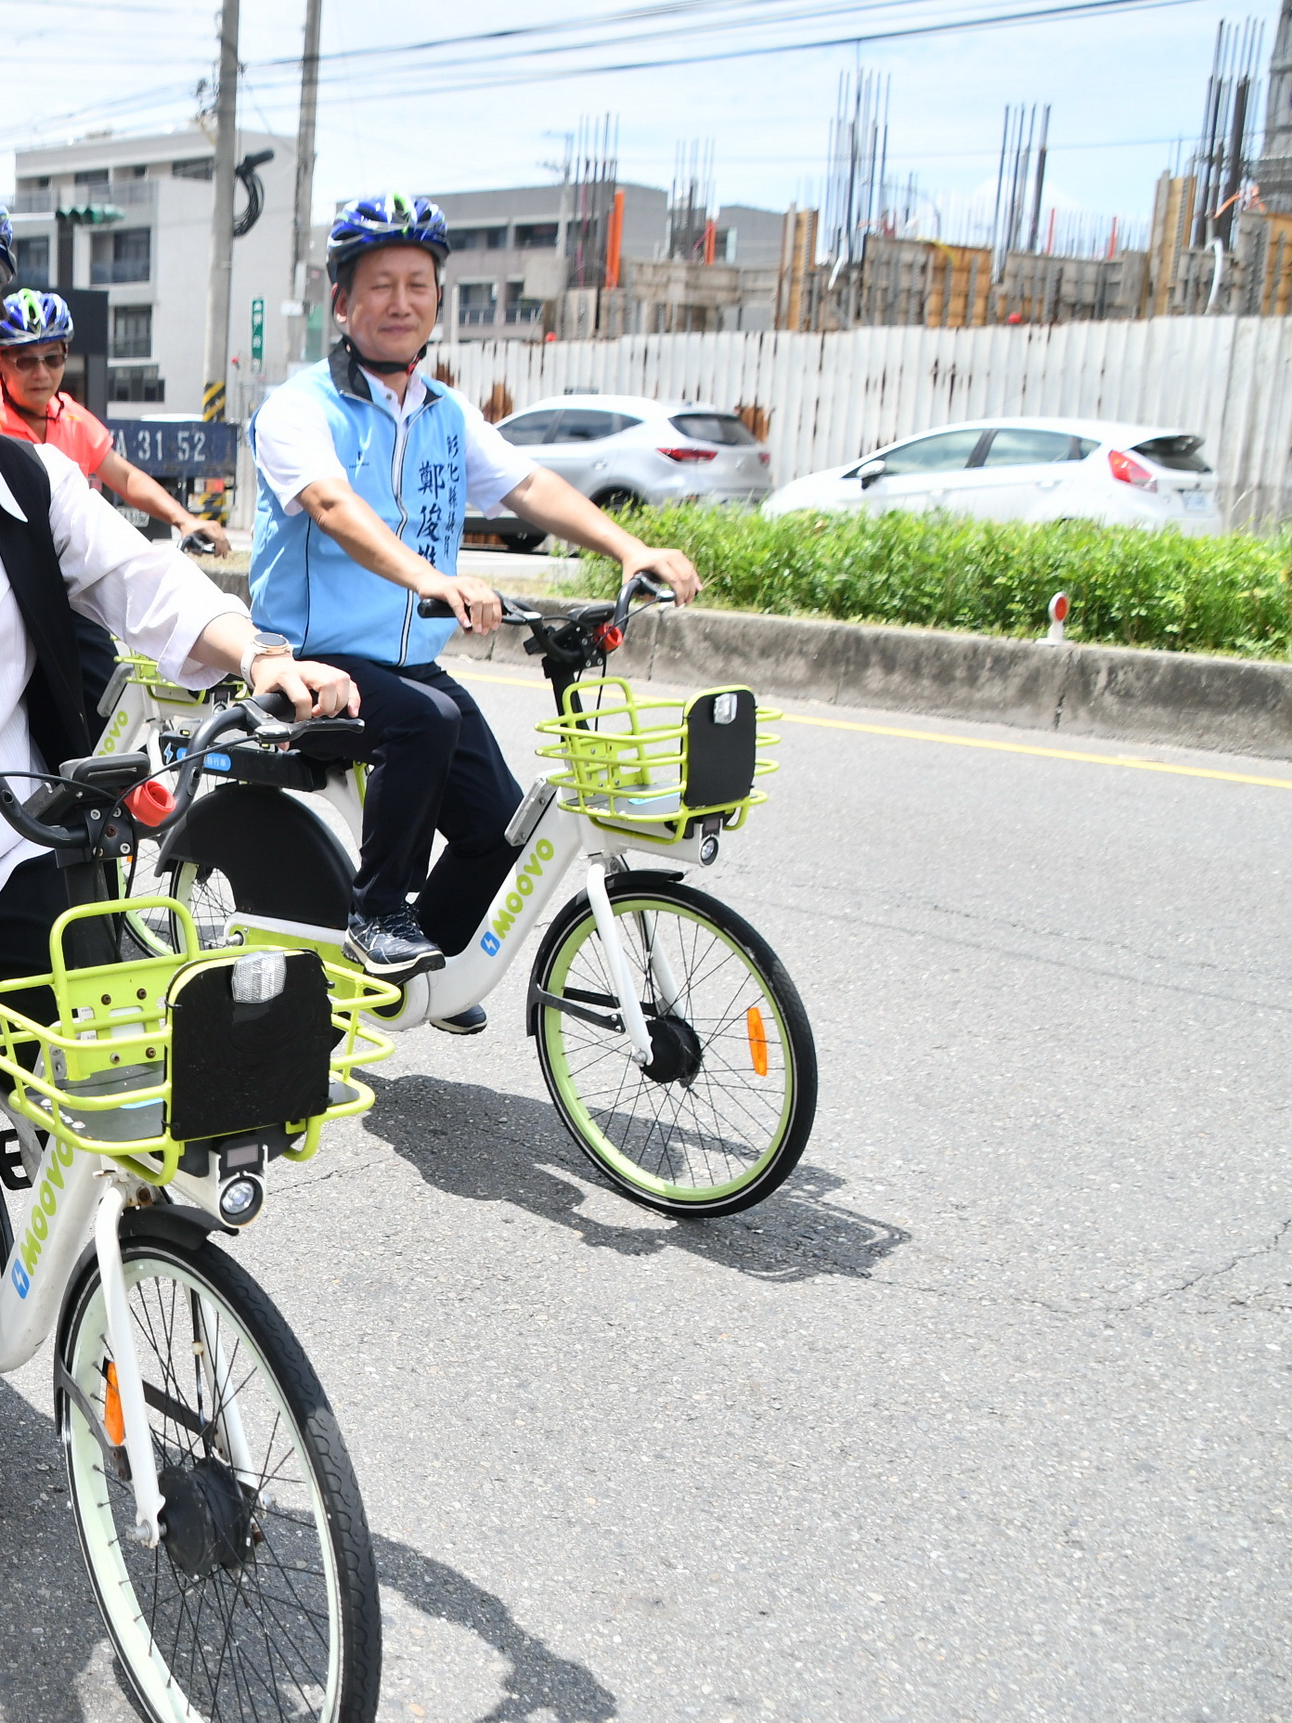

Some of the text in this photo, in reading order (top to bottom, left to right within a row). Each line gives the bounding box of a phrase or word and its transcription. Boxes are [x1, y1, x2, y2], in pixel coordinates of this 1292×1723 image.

[177, 431, 206, 461] 52
[97, 710, 129, 756] OVO
[492, 838, 554, 940] MOOVO
[20, 1136, 74, 1277] MOOVO
